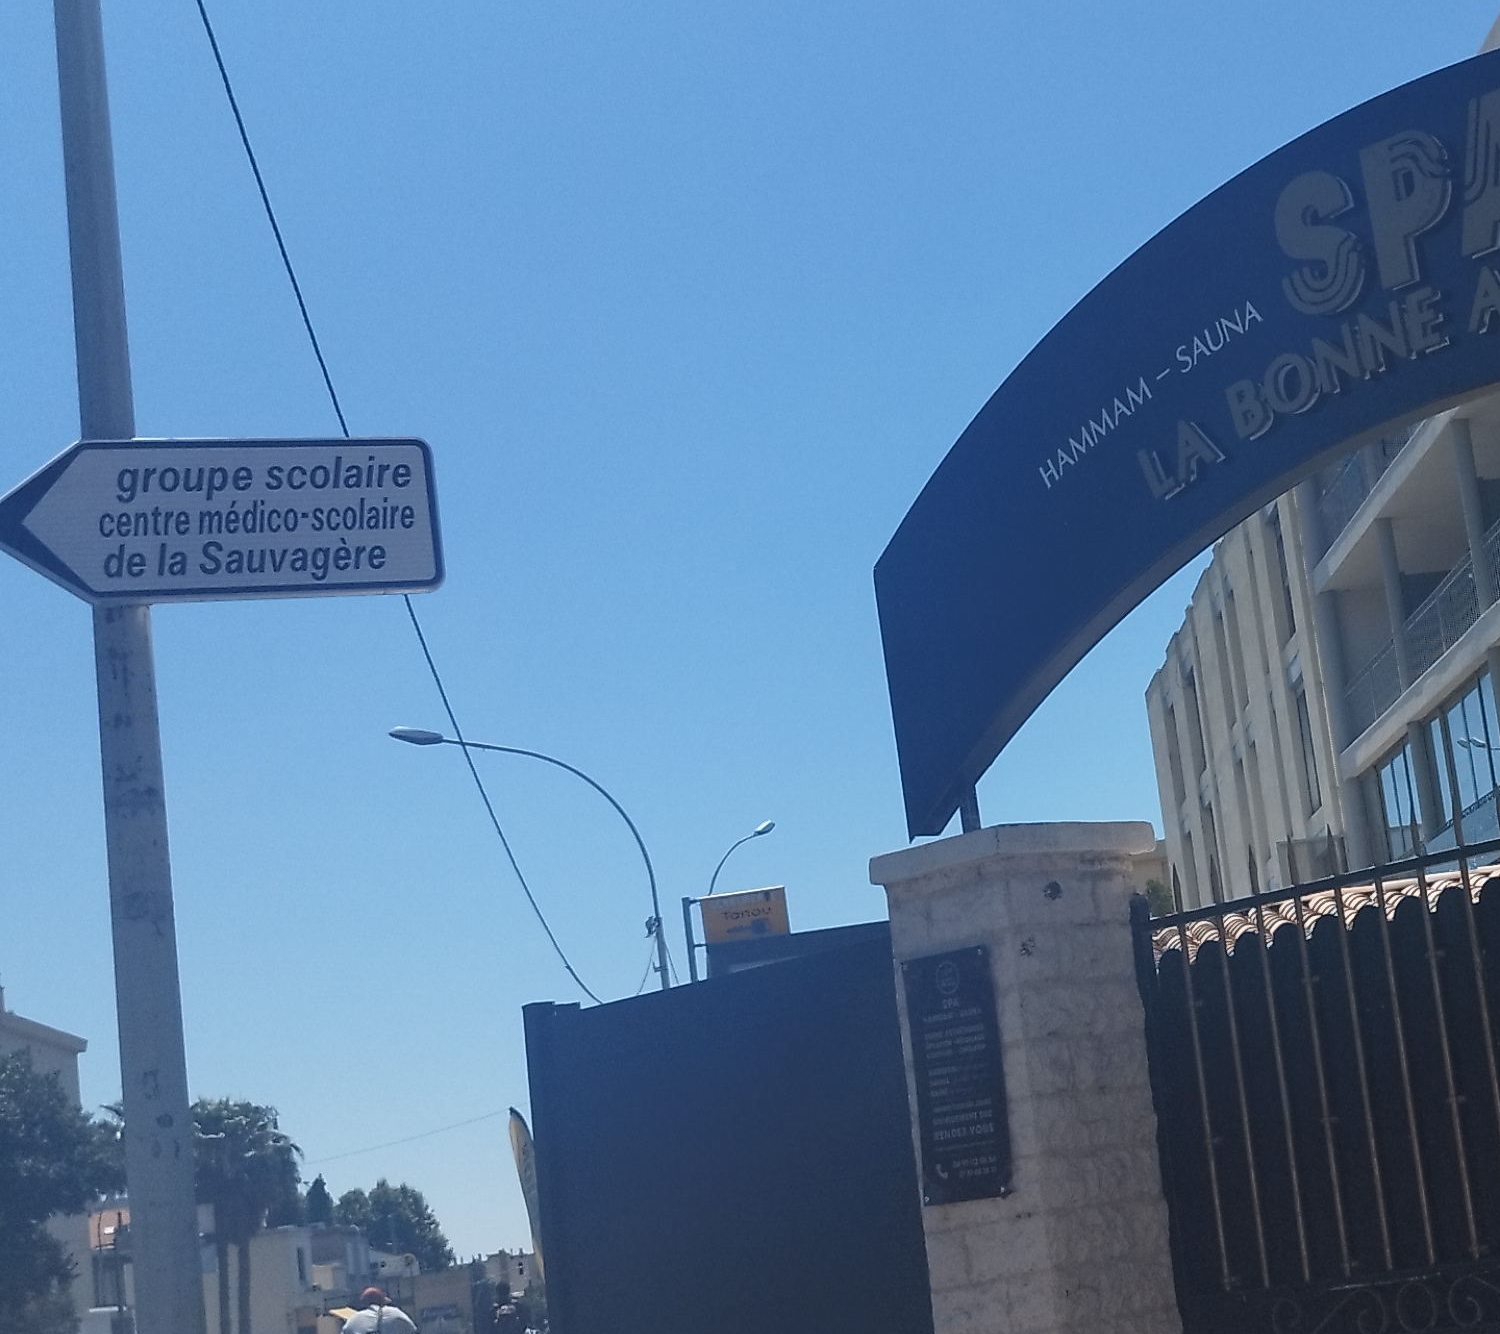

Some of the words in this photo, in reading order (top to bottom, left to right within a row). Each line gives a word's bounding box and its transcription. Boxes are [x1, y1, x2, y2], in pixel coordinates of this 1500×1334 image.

[1038, 376, 1153, 489] HAMMAM
[1175, 300, 1264, 373] SAUNA
[1136, 419, 1226, 501] LA
[1224, 286, 1450, 441] BONNE
[116, 464, 253, 503] groupe
[264, 455, 412, 492] scolaire
[98, 505, 190, 538] centre
[199, 497, 415, 536] médico-scolaire
[103, 543, 147, 578] de
[157, 543, 188, 576] la
[199, 537, 387, 581] Sauvagère
[969, 1123, 995, 1135] VOUS
